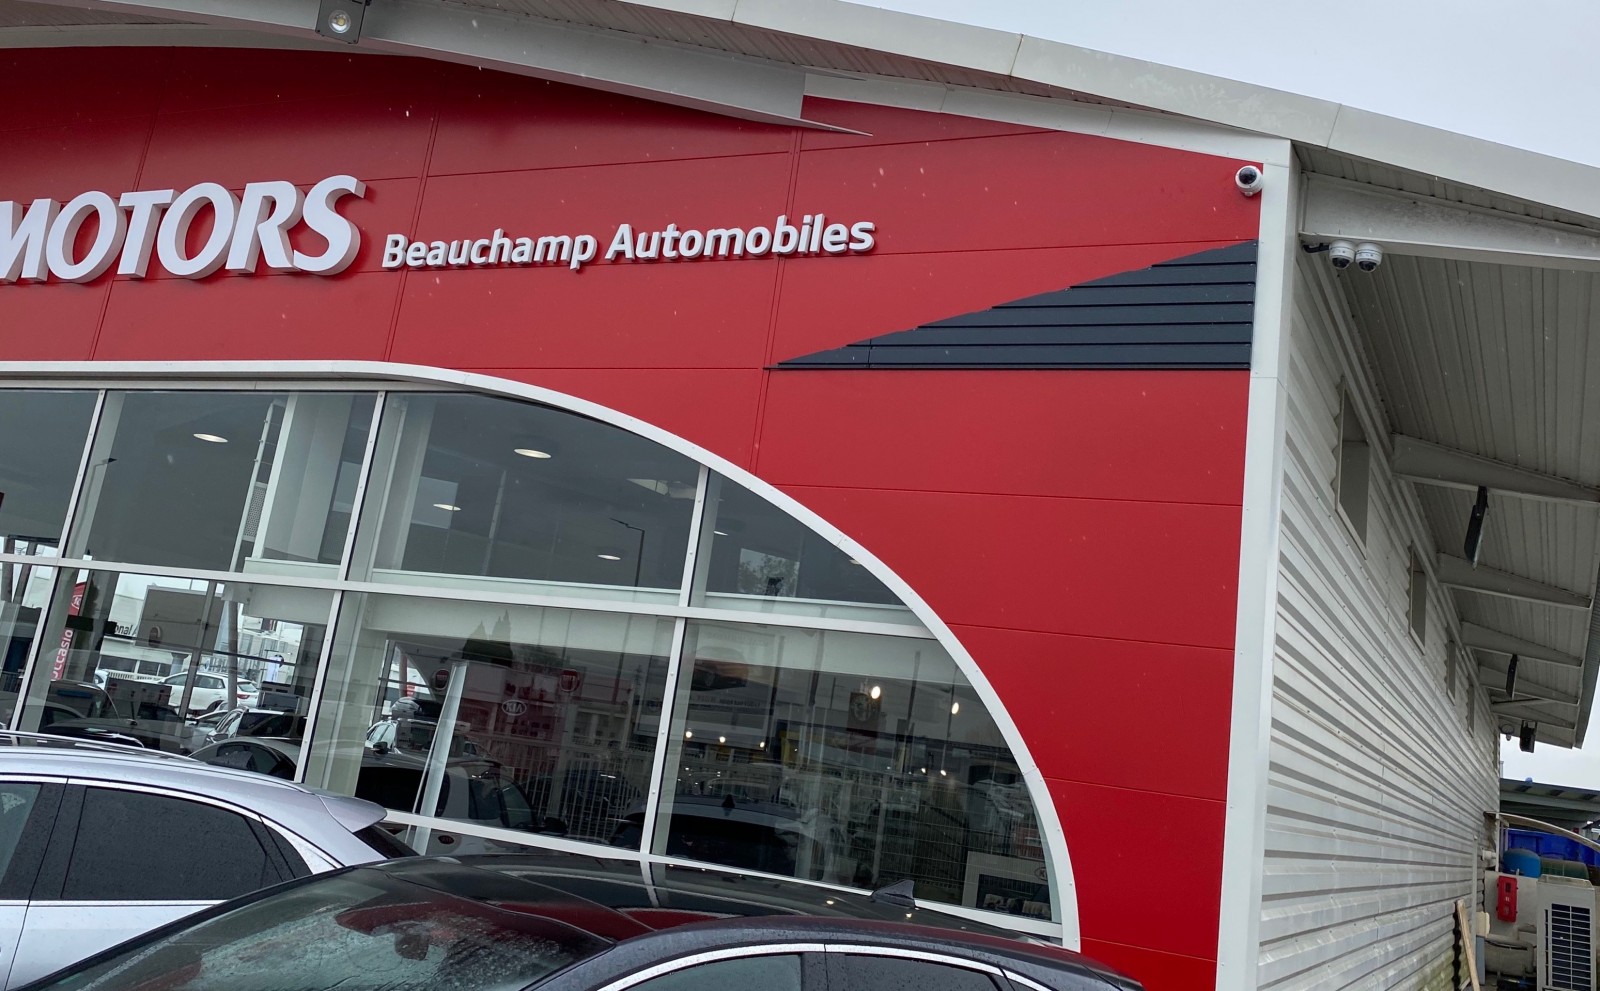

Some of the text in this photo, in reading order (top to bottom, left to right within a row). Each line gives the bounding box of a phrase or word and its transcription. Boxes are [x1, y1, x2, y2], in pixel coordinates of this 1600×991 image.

[0, 175, 366, 283] MOTORS
[382, 213, 876, 273] Beauchamp Automobiles
